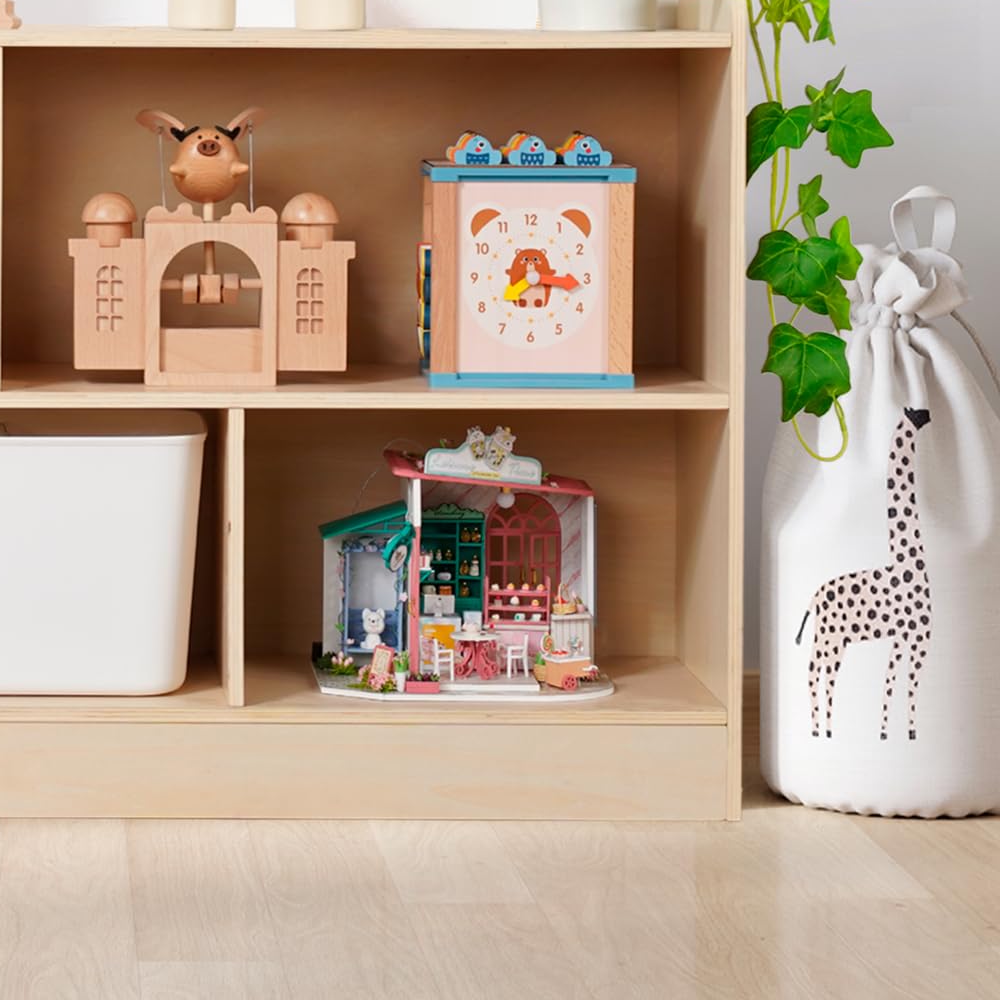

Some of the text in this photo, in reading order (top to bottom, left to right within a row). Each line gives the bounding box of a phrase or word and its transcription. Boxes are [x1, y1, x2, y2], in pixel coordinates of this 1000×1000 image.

[524, 213, 538, 226] 12
[497, 221, 508, 233] 11
[556, 221, 562, 234] 1
[475, 242, 490, 256] 10
[575, 243, 584, 256] 2
[470, 271, 479, 284] 9
[583, 272, 592, 285] 3
[477, 301, 487, 314] 8
[575, 301, 584, 314] 4
[498, 322, 507, 335] 7
[555, 323, 563, 336] 5
[526, 331, 535, 343] 6
